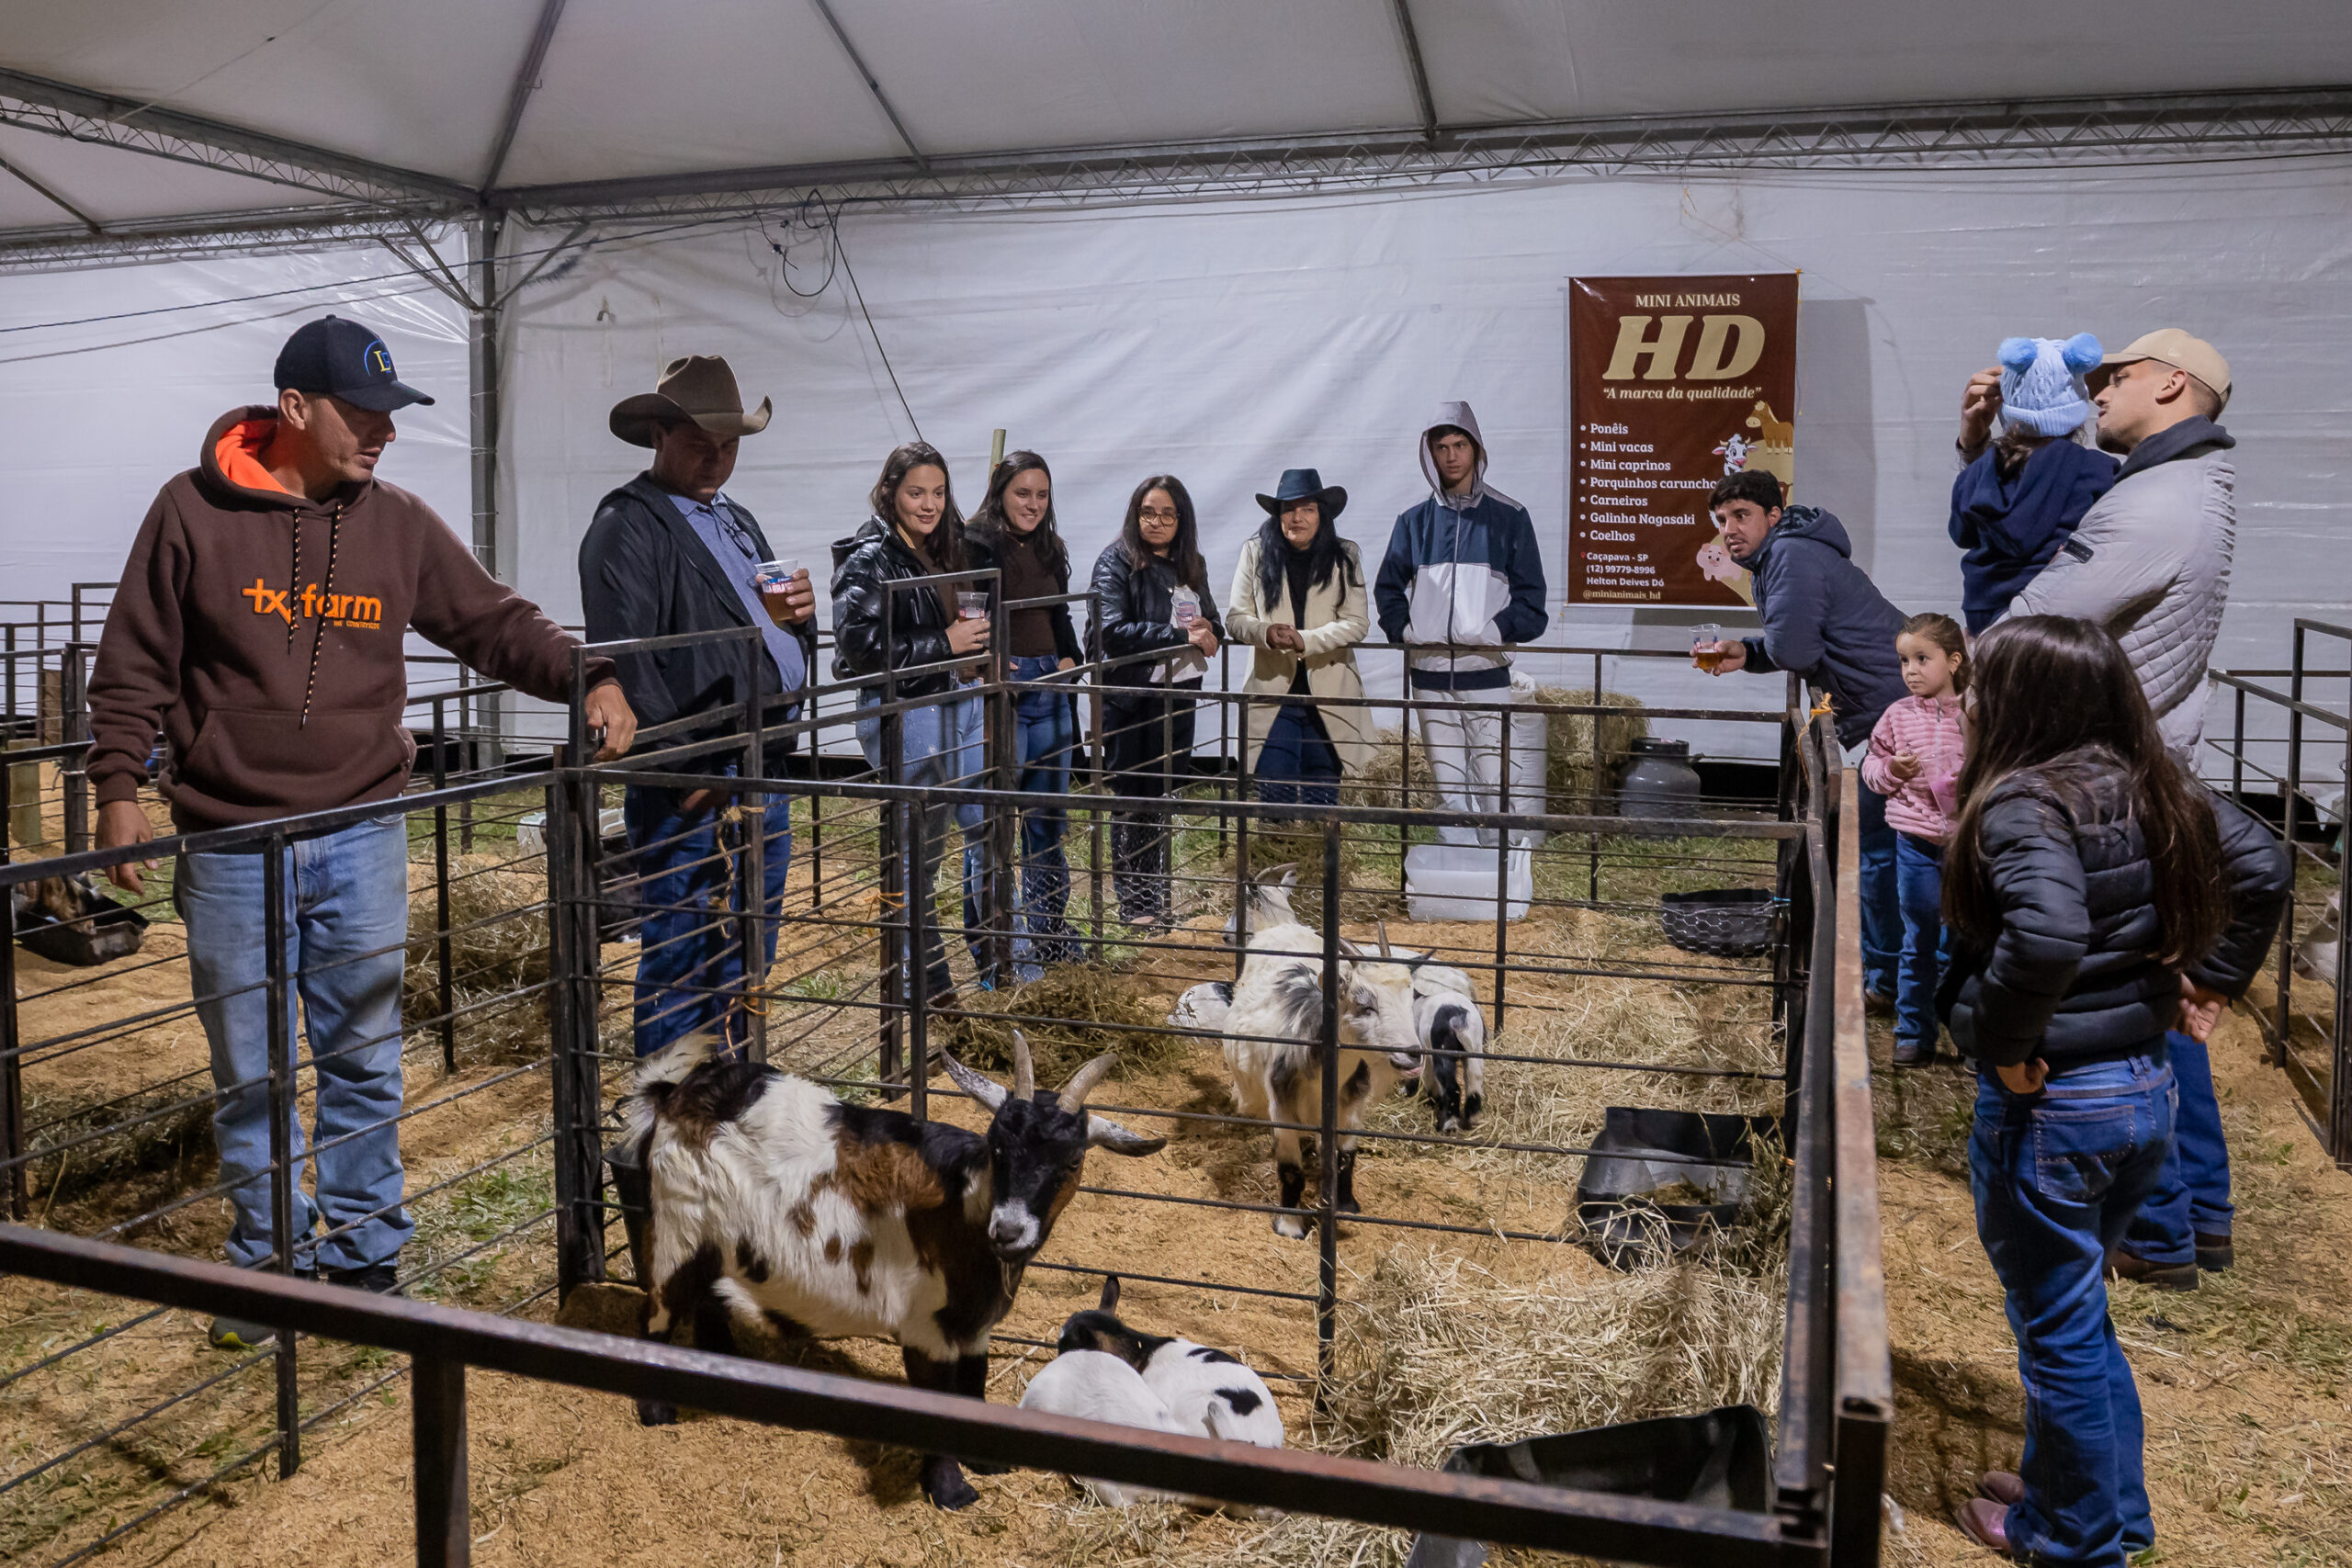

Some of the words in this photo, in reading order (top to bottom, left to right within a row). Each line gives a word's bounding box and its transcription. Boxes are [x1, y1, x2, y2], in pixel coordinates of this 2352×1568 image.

[1635, 294, 1671, 308] MINI
[1675, 293, 1741, 307] ANIMAIS
[1602, 315, 1766, 379] HD
[1620, 389, 1664, 399] marca
[1667, 387, 1683, 399] da
[1590, 423, 1629, 434] Ponêis
[1590, 441, 1616, 452] Mini
[1620, 444, 1654, 453] vacas
[1590, 459, 1616, 470] Mini
[1619, 460, 1671, 472] caprinos
[1590, 477, 1657, 490] Porquinhos
[1659, 478, 1718, 489] caruncho
[1590, 494, 1648, 506] Carneiros
[1590, 513, 1636, 524] Galinha
[1639, 513, 1695, 526] Nagasaki
[1590, 530, 1635, 542] Coelhos
[1587, 552, 1630, 562] Caçapava
[1637, 554, 1648, 562] SP
[1587, 565, 1603, 573] (12)
[1605, 565, 1656, 574] 99779-8996
[1587, 577, 1617, 585] Helton
[1620, 578, 1649, 586] Deives
[1652, 579, 1665, 587] Dó
